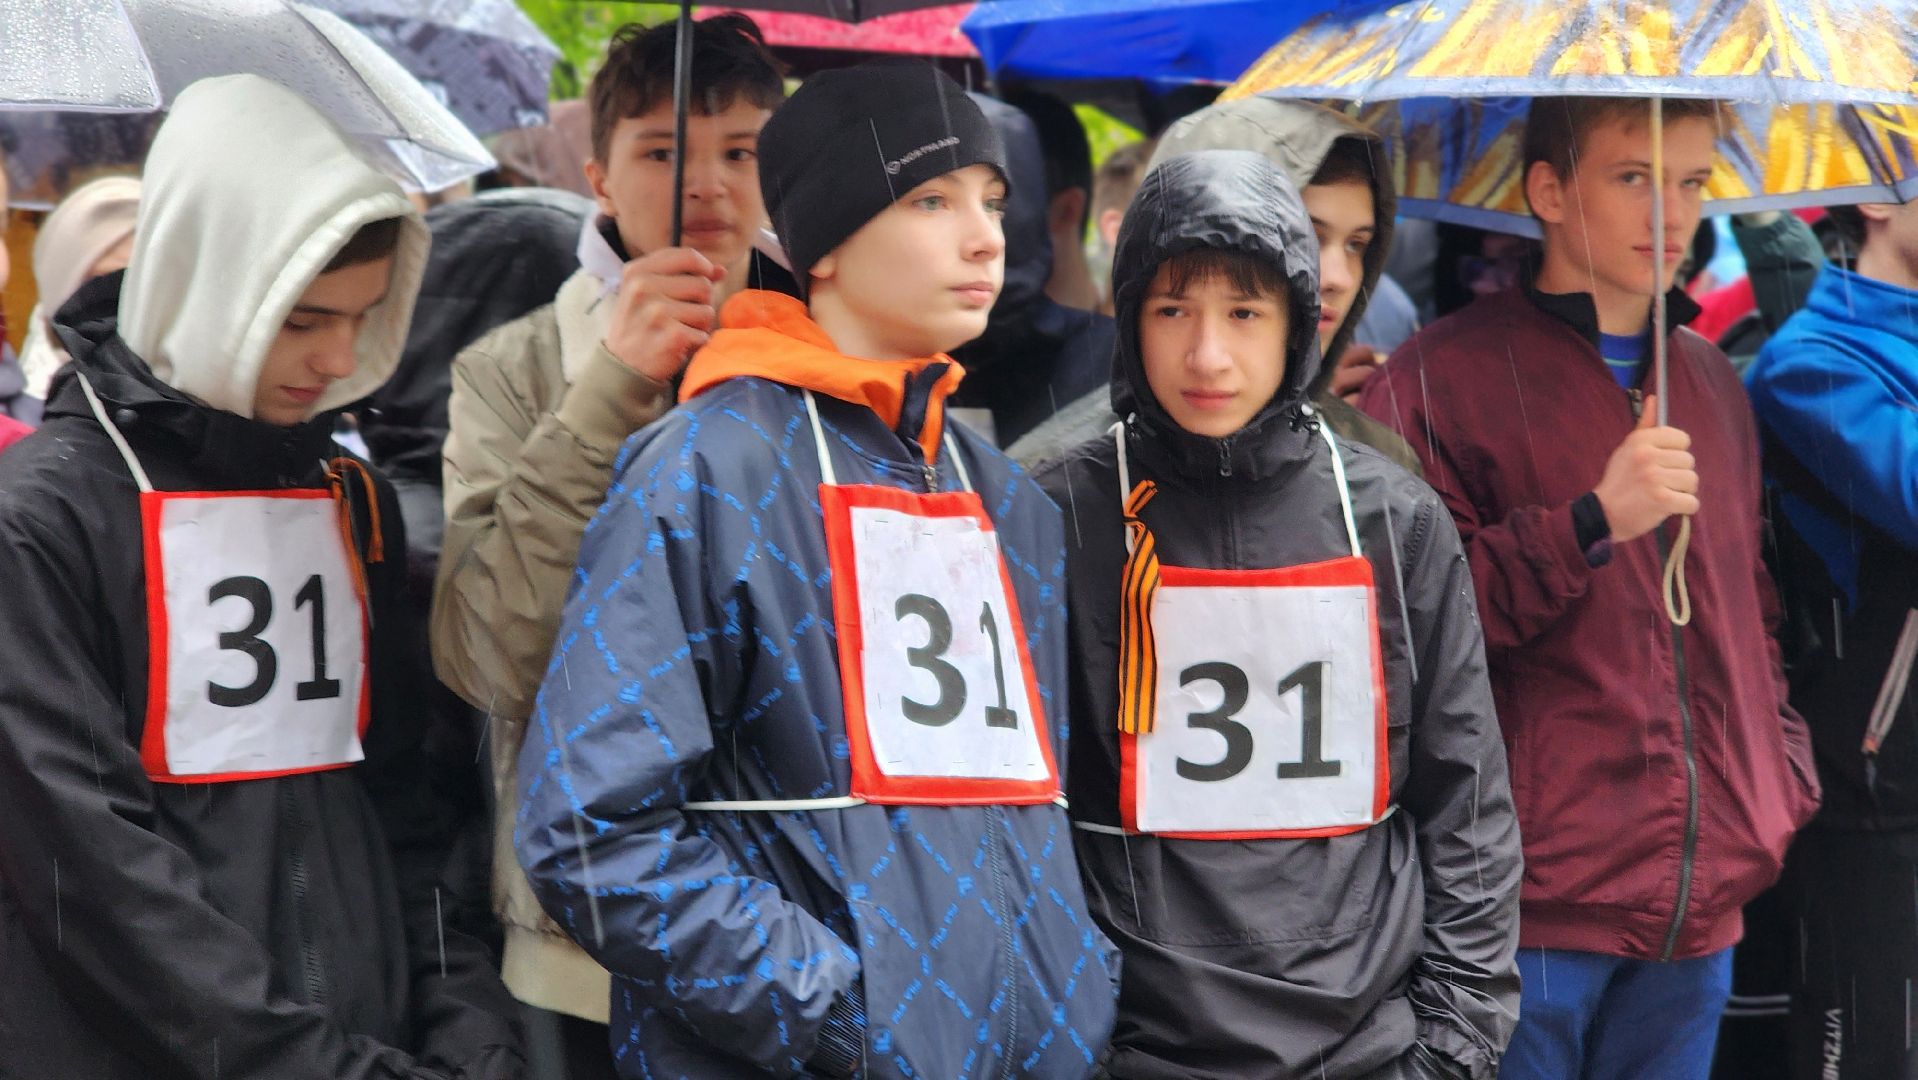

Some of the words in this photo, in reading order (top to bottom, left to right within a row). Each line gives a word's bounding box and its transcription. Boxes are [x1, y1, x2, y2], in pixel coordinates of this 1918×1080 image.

[206, 574, 341, 708] 31
[894, 592, 1019, 730] 31
[1175, 660, 1342, 783] 31
